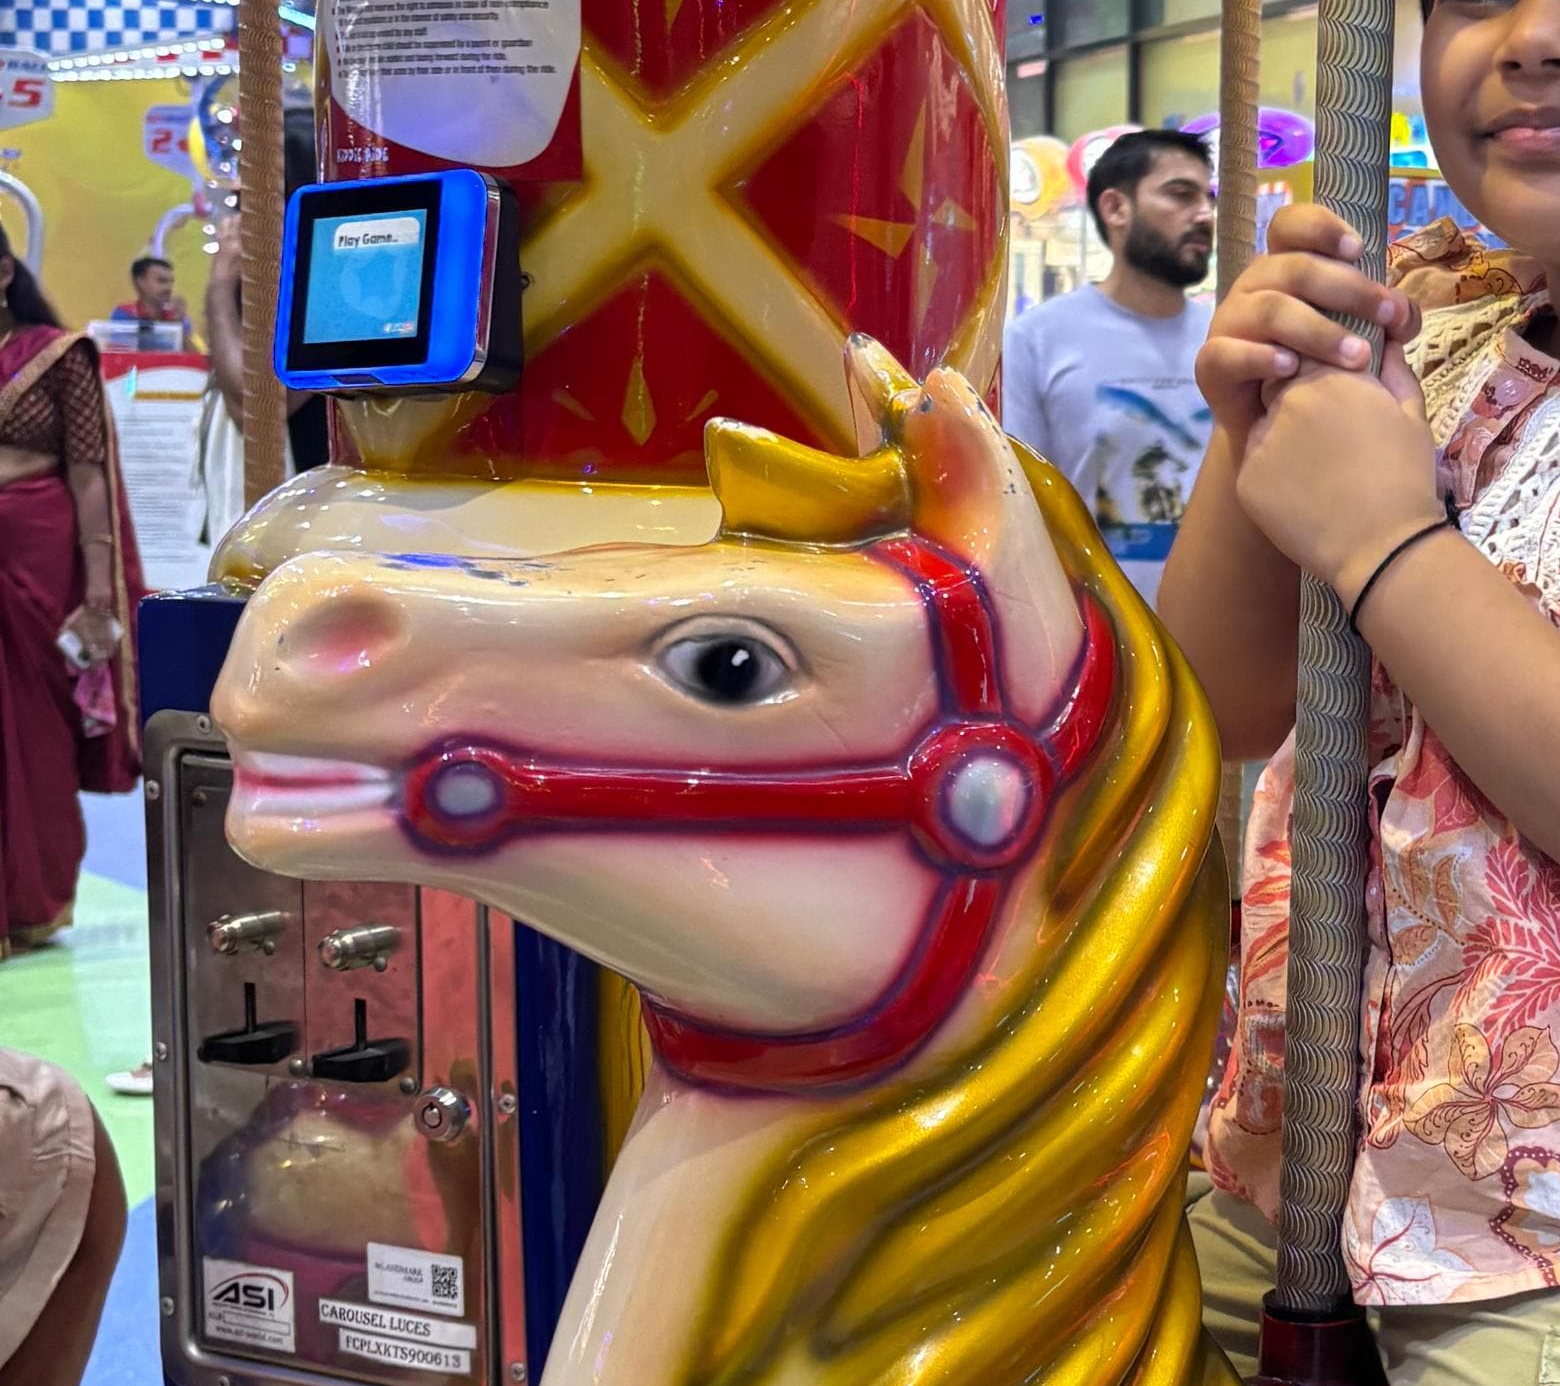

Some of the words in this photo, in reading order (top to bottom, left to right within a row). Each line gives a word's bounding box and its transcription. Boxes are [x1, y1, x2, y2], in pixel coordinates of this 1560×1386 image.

[338, 235, 361, 249] Play
[213, 1281, 275, 1312] ASI
[320, 1303, 387, 1330] CAROUSEL
[390, 1316, 432, 1338] LUCES
